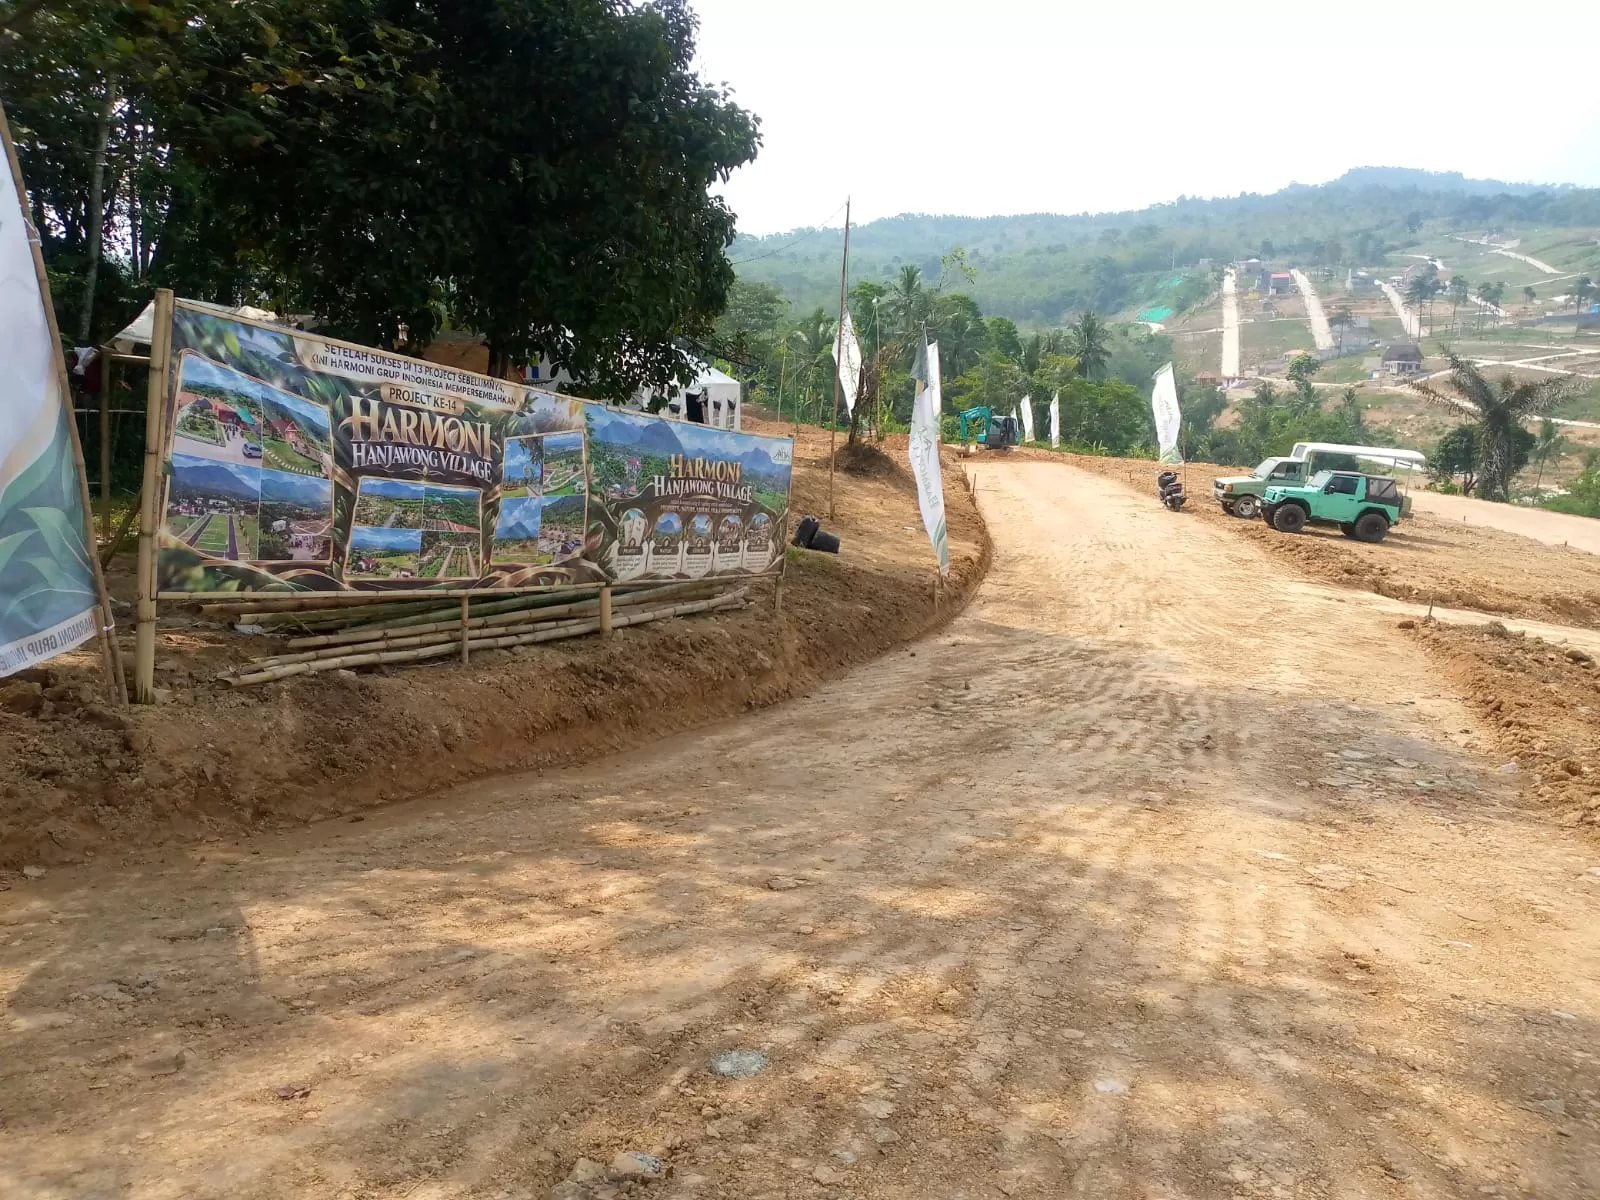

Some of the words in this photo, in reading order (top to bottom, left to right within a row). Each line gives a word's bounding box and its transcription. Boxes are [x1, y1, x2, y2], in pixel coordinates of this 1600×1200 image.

[325, 343, 368, 362] SETELAH
[371, 353, 402, 369] SUKSES
[404, 361, 412, 371] DI
[414, 363, 423, 373] 13
[311, 352, 328, 366] KINI
[330, 358, 374, 375] HARMONI
[377, 367, 400, 379] GRUP
[402, 372, 443, 389] INDONESIA
[446, 382, 516, 406] MEMPERSEMBAHKAN
[389, 387, 431, 406] PROJECT
[433, 395, 457, 411] KE-14
[340, 395, 500, 462] HARMONI
[352, 443, 438, 469] HANJAWONG
[439, 451, 493, 483] VILLAGE
[668, 453, 742, 484] HARMONI
[653, 475, 715, 498] HANJAWONG
[716, 481, 753, 503] VILLAGE
